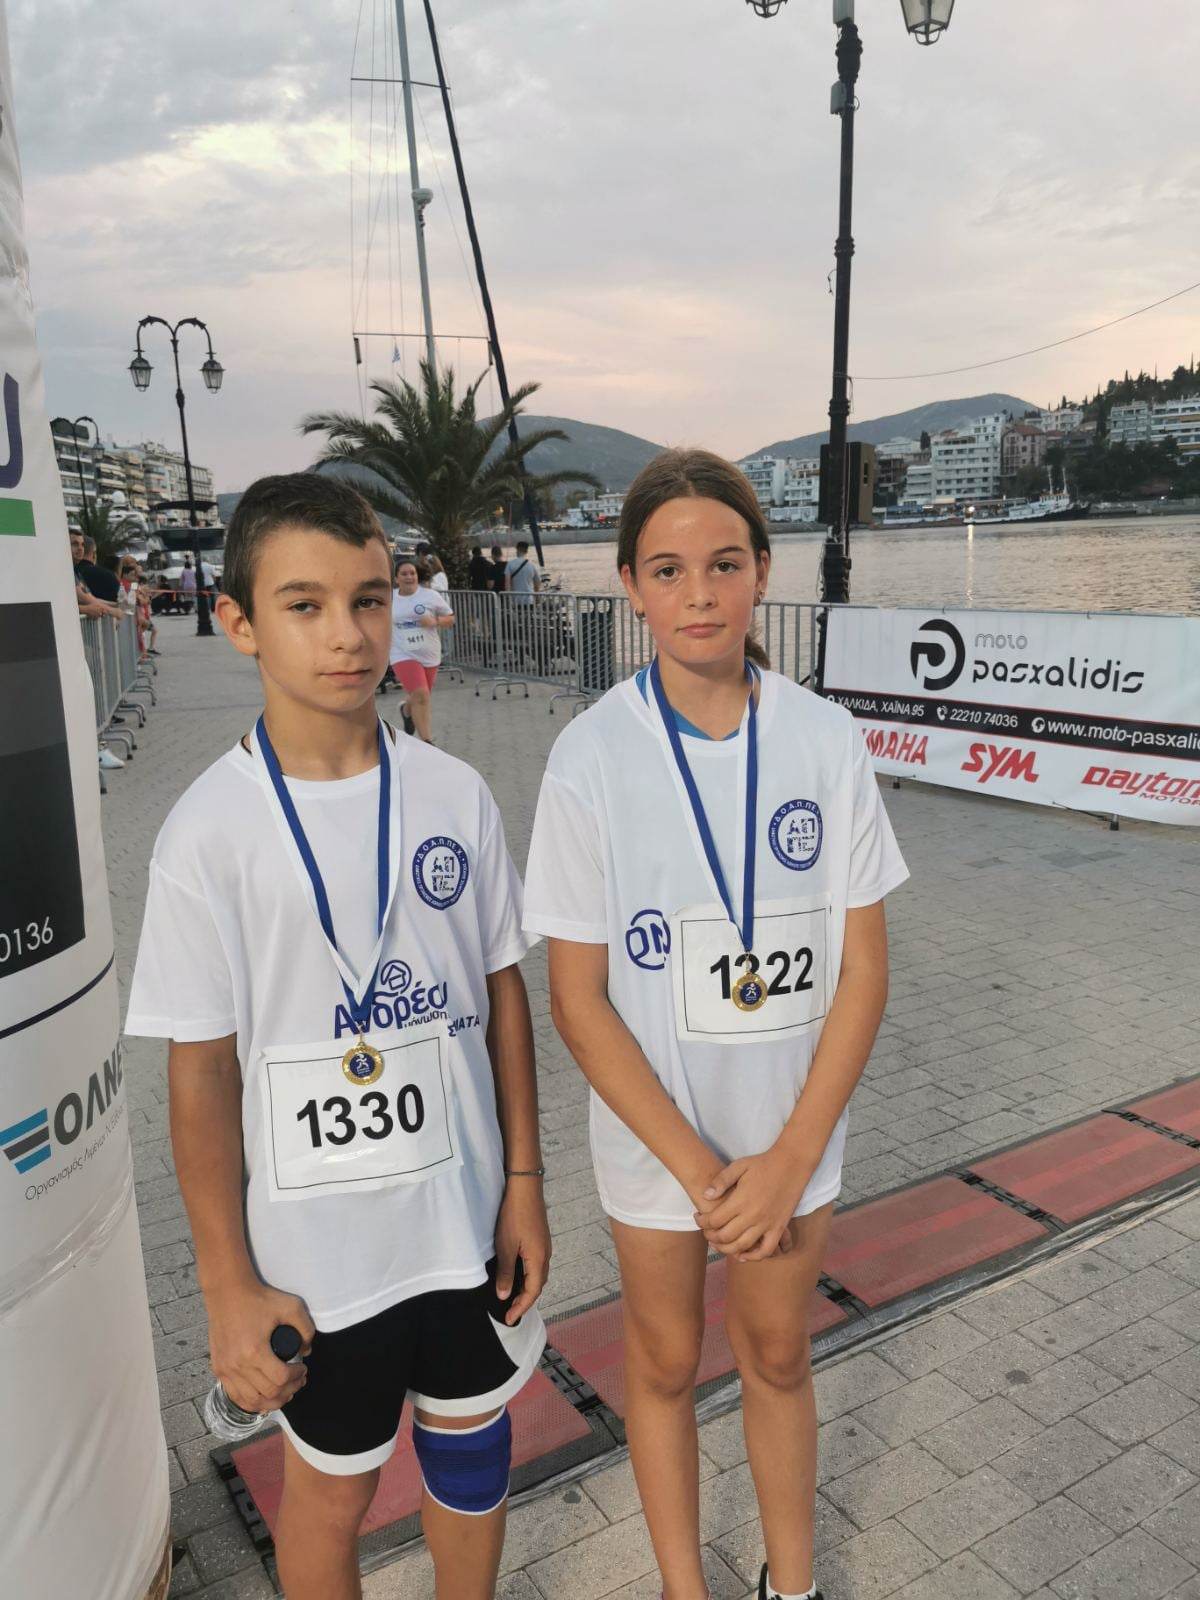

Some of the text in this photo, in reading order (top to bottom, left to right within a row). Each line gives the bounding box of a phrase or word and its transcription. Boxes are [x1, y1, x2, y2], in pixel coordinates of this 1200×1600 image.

[974, 633, 1028, 650] moto
[972, 656, 1145, 693] pasxalidis
[911, 704, 925, 717] 95
[950, 708, 1018, 728] 22210 74036
[961, 742, 1039, 783] SYM
[296, 1083, 425, 1148] 1330
